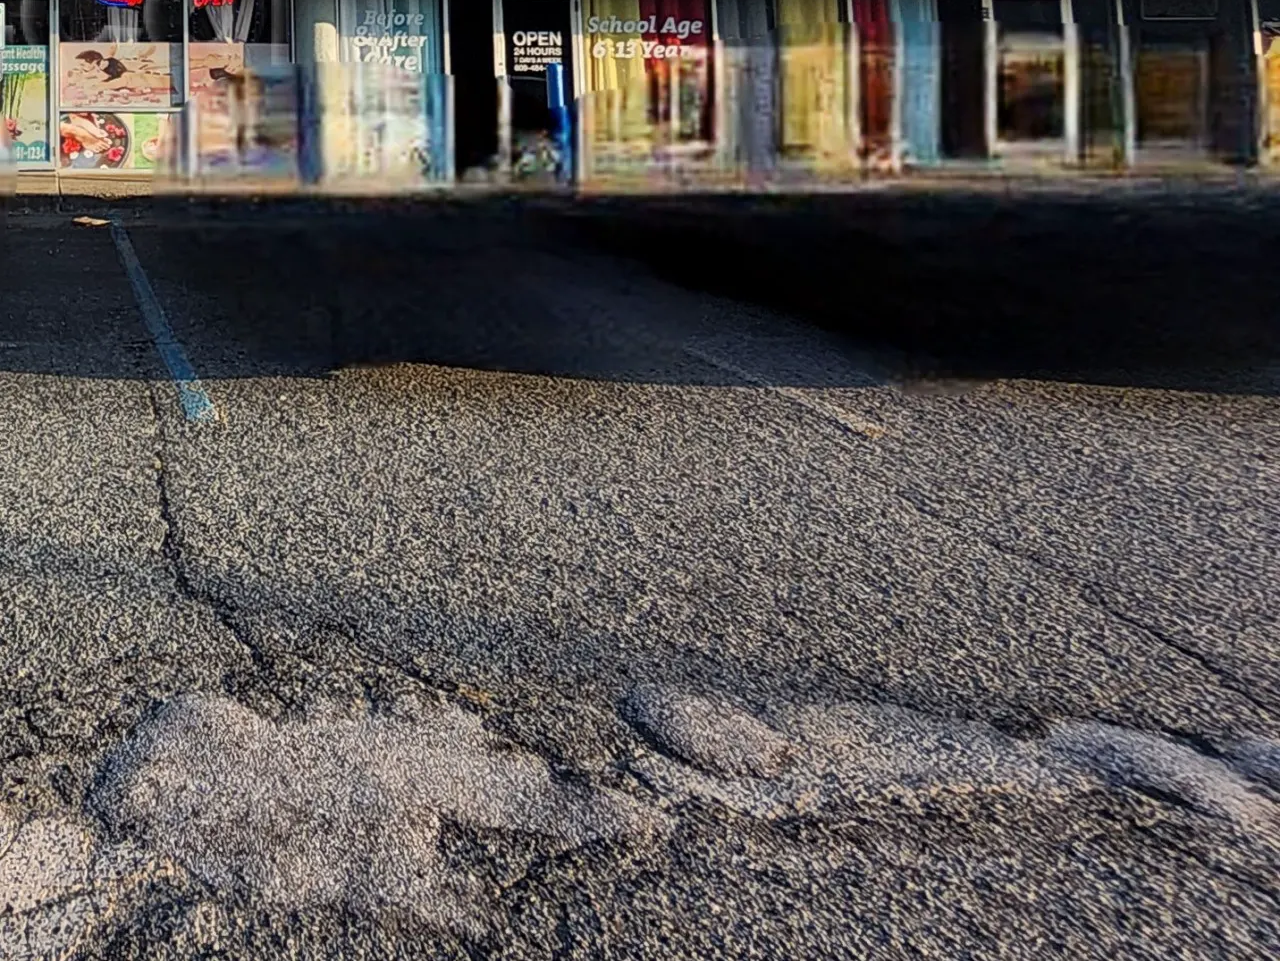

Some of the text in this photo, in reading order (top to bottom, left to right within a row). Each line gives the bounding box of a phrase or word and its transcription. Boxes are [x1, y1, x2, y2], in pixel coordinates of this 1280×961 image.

[363, 9, 424, 30] Before
[588, 16, 702, 39] School Age
[378, 30, 428, 52] After
[512, 30, 562, 46] OPEN
[513, 47, 562, 56] 24 HOURS
[2, 62, 45, 74] assage
